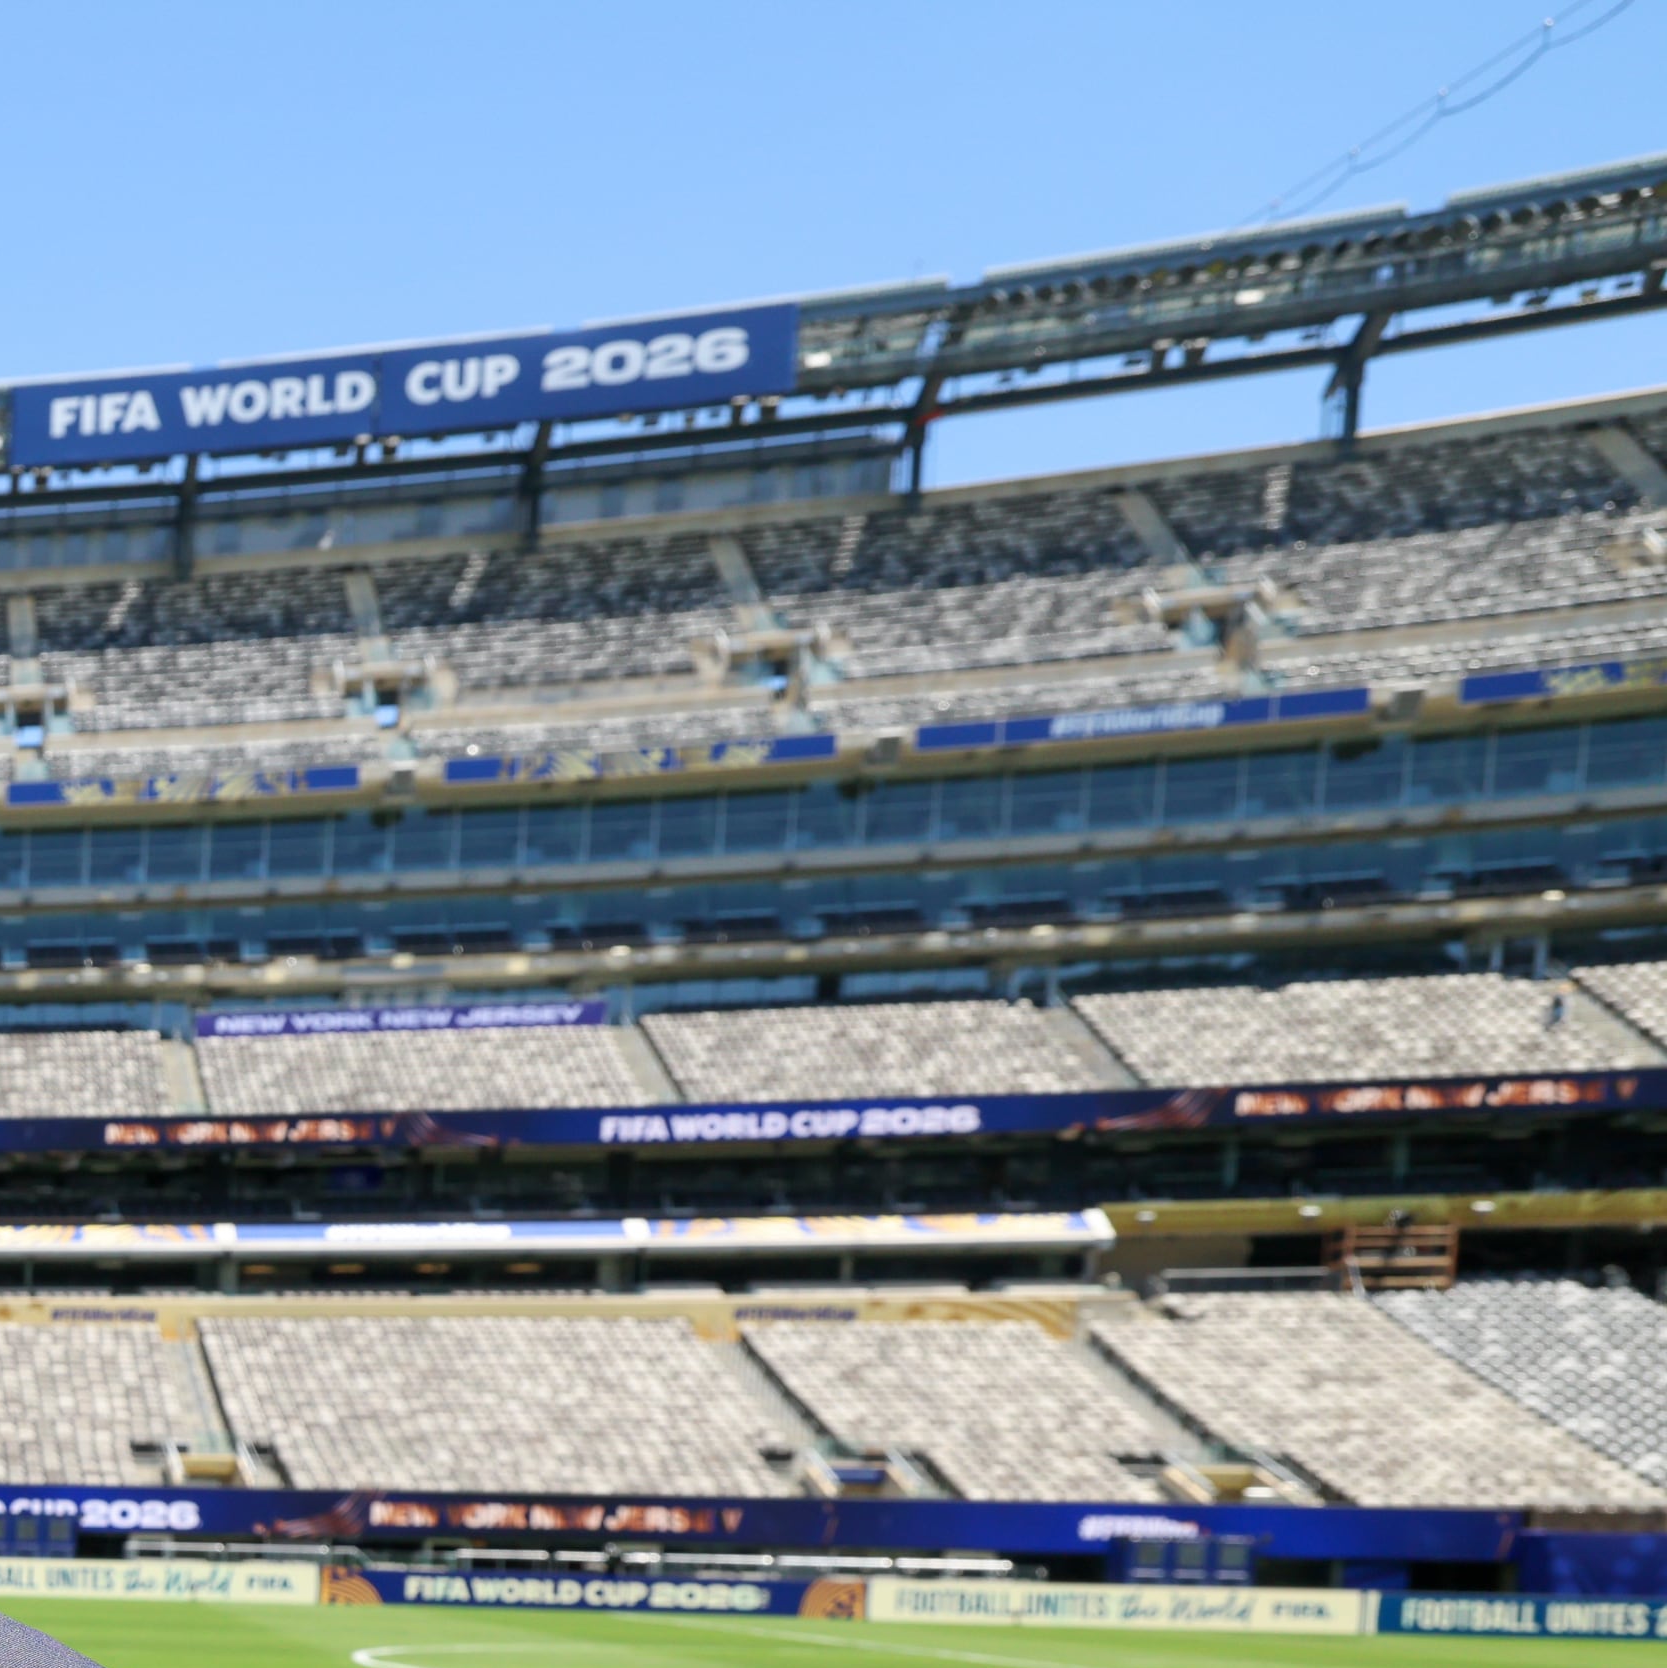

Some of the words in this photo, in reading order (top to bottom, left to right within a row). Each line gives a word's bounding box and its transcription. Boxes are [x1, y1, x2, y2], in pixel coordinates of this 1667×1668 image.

[49, 389, 162, 439] FIFA
[179, 370, 376, 428] WORLD
[404, 354, 520, 406] CUP
[540, 327, 750, 392] 2026
[213, 1012, 287, 1035] NEW
[290, 1010, 374, 1033] YORK
[378, 1007, 453, 1030] NEW
[454, 1003, 584, 1027] JERSEY
[599, 1114, 669, 1143] FIFA
[668, 1111, 790, 1141] WORLD
[789, 1109, 859, 1138] CUP
[858, 1105, 981, 1136] 2026
[79, 1498, 201, 1531] 2026
[45, 1565, 114, 1591] UNITES
[123, 1565, 157, 1593] the
[165, 1566, 234, 1595] World
[245, 1573, 293, 1592] FIFA
[403, 1575, 472, 1602] FIFA
[470, 1577, 582, 1606] WORLD
[584, 1580, 650, 1608] CUP
[648, 1582, 763, 1611] 2026
[895, 1588, 1011, 1615] FOOTBALL
[1021, 1592, 1107, 1618] UNITES
[1271, 1601, 1333, 1621] FIFA
[1400, 1597, 1540, 1633] FOOTBALL
[1545, 1601, 1650, 1636] UNITES
